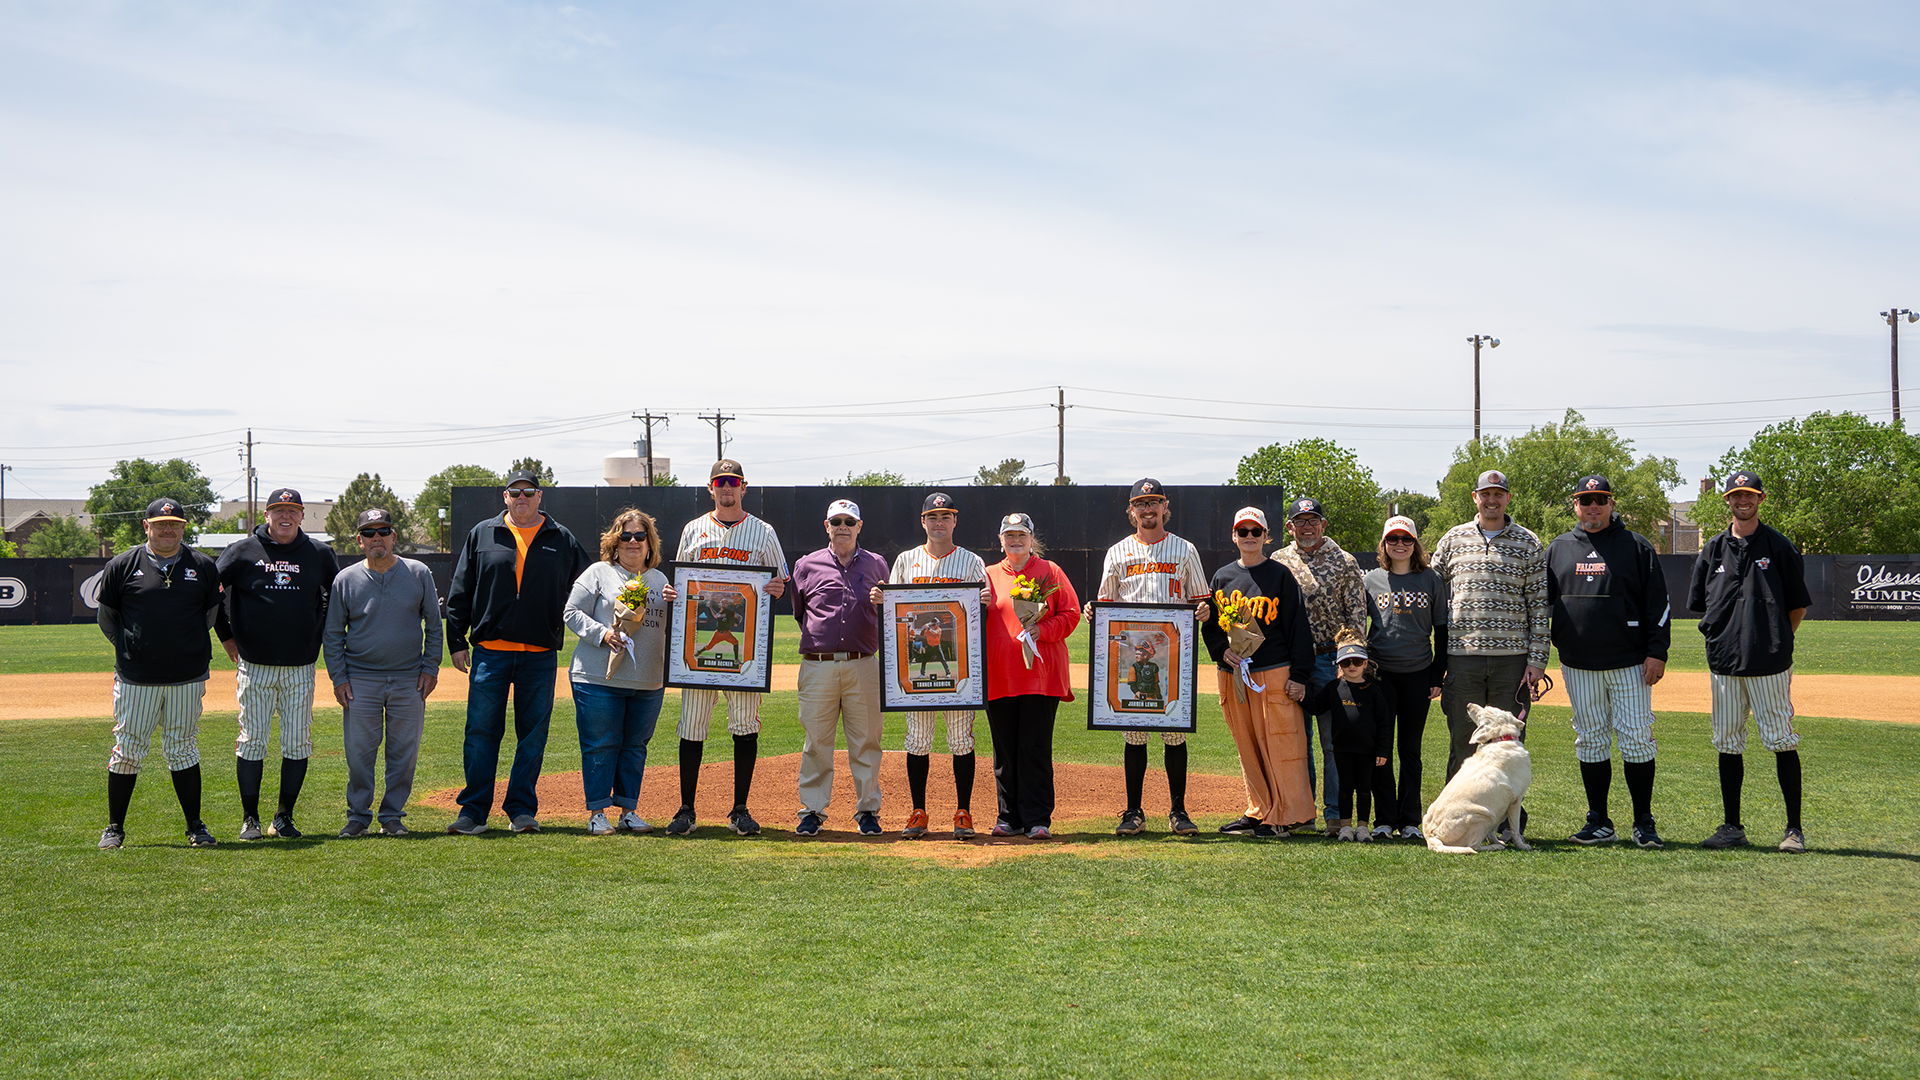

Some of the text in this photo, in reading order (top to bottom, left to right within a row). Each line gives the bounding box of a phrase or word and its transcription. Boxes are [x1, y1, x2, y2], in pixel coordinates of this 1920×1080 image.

[698, 547, 752, 562] FALCONS
[265, 563, 300, 573] FALCONS
[1126, 562, 1179, 578] FALCONS
[1576, 563, 1606, 571] FALCONS
[1169, 578, 1182, 598] 14
[1378, 592, 1428, 609] UTPB
[1853, 590, 1920, 601] PUMPS
[646, 608, 664, 617] RITE
